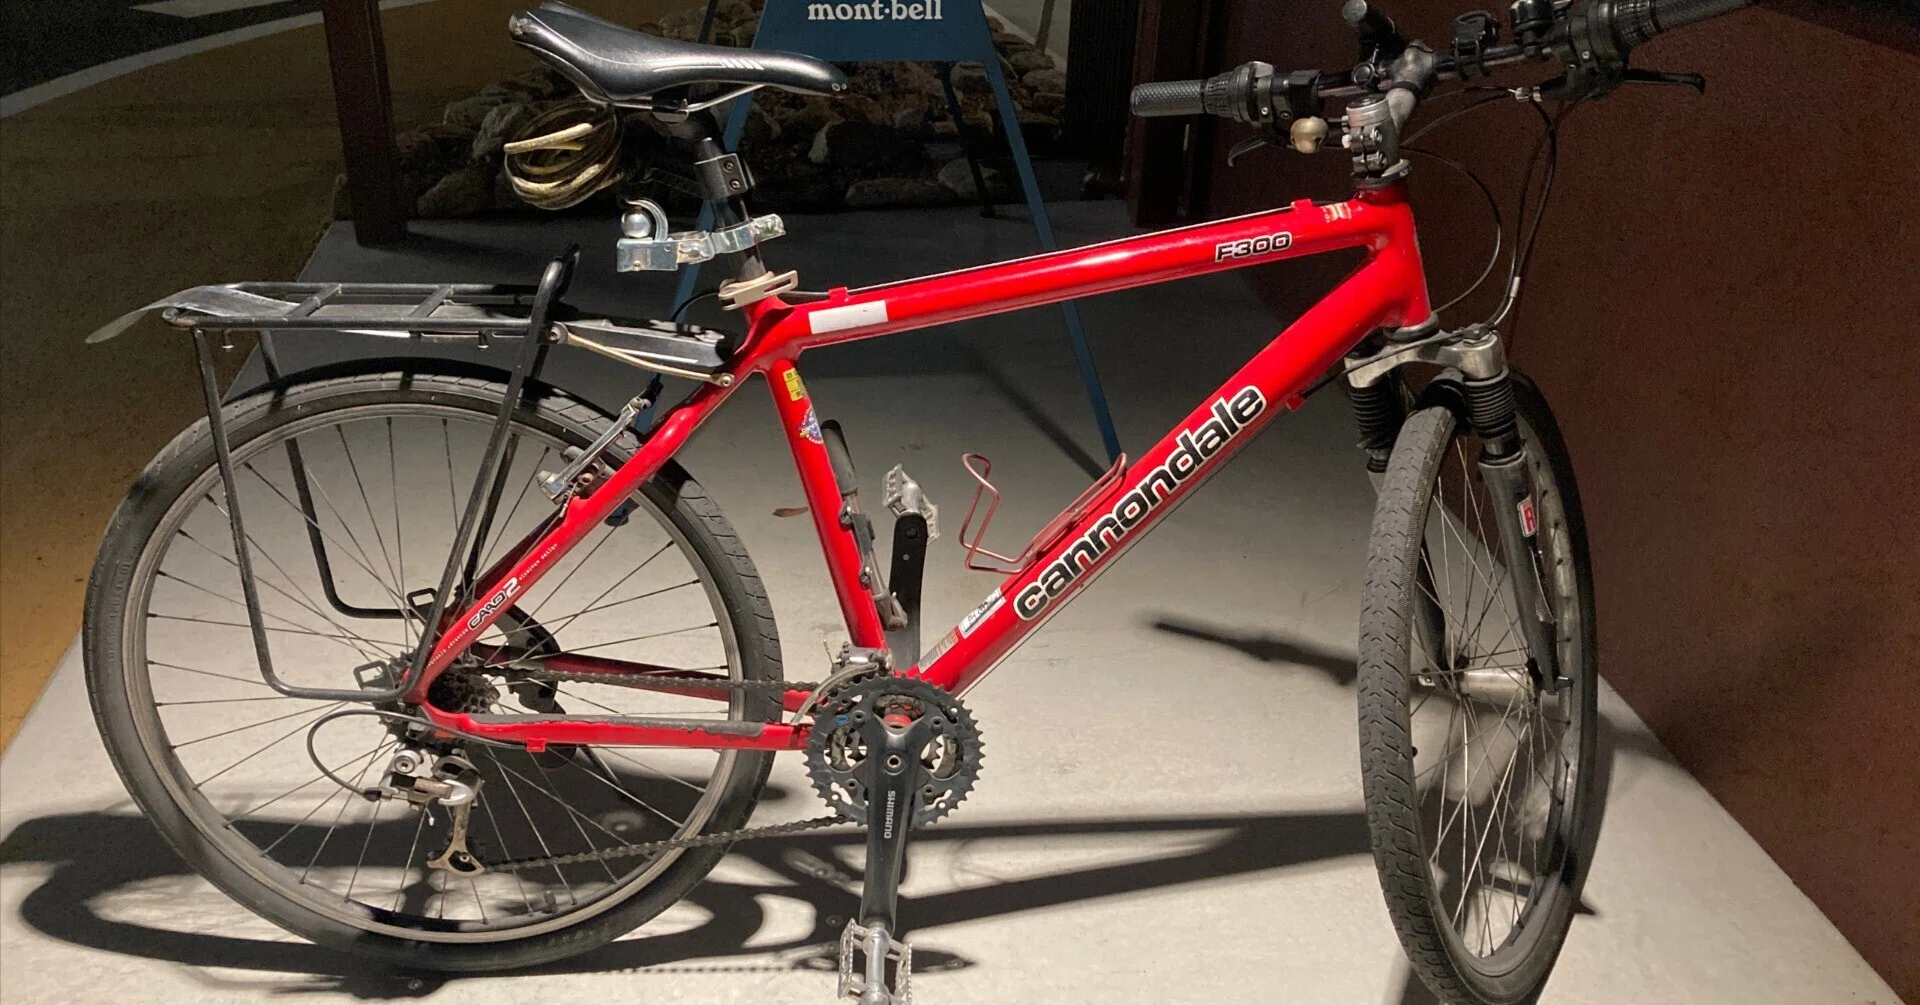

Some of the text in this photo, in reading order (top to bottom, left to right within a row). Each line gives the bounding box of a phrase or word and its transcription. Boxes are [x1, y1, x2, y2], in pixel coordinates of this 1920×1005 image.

[1215, 231, 1292, 262] F300
[1013, 385, 1267, 621] cannondale
[468, 577, 521, 630] CAAD2
[884, 790, 895, 839] SHIMANO
